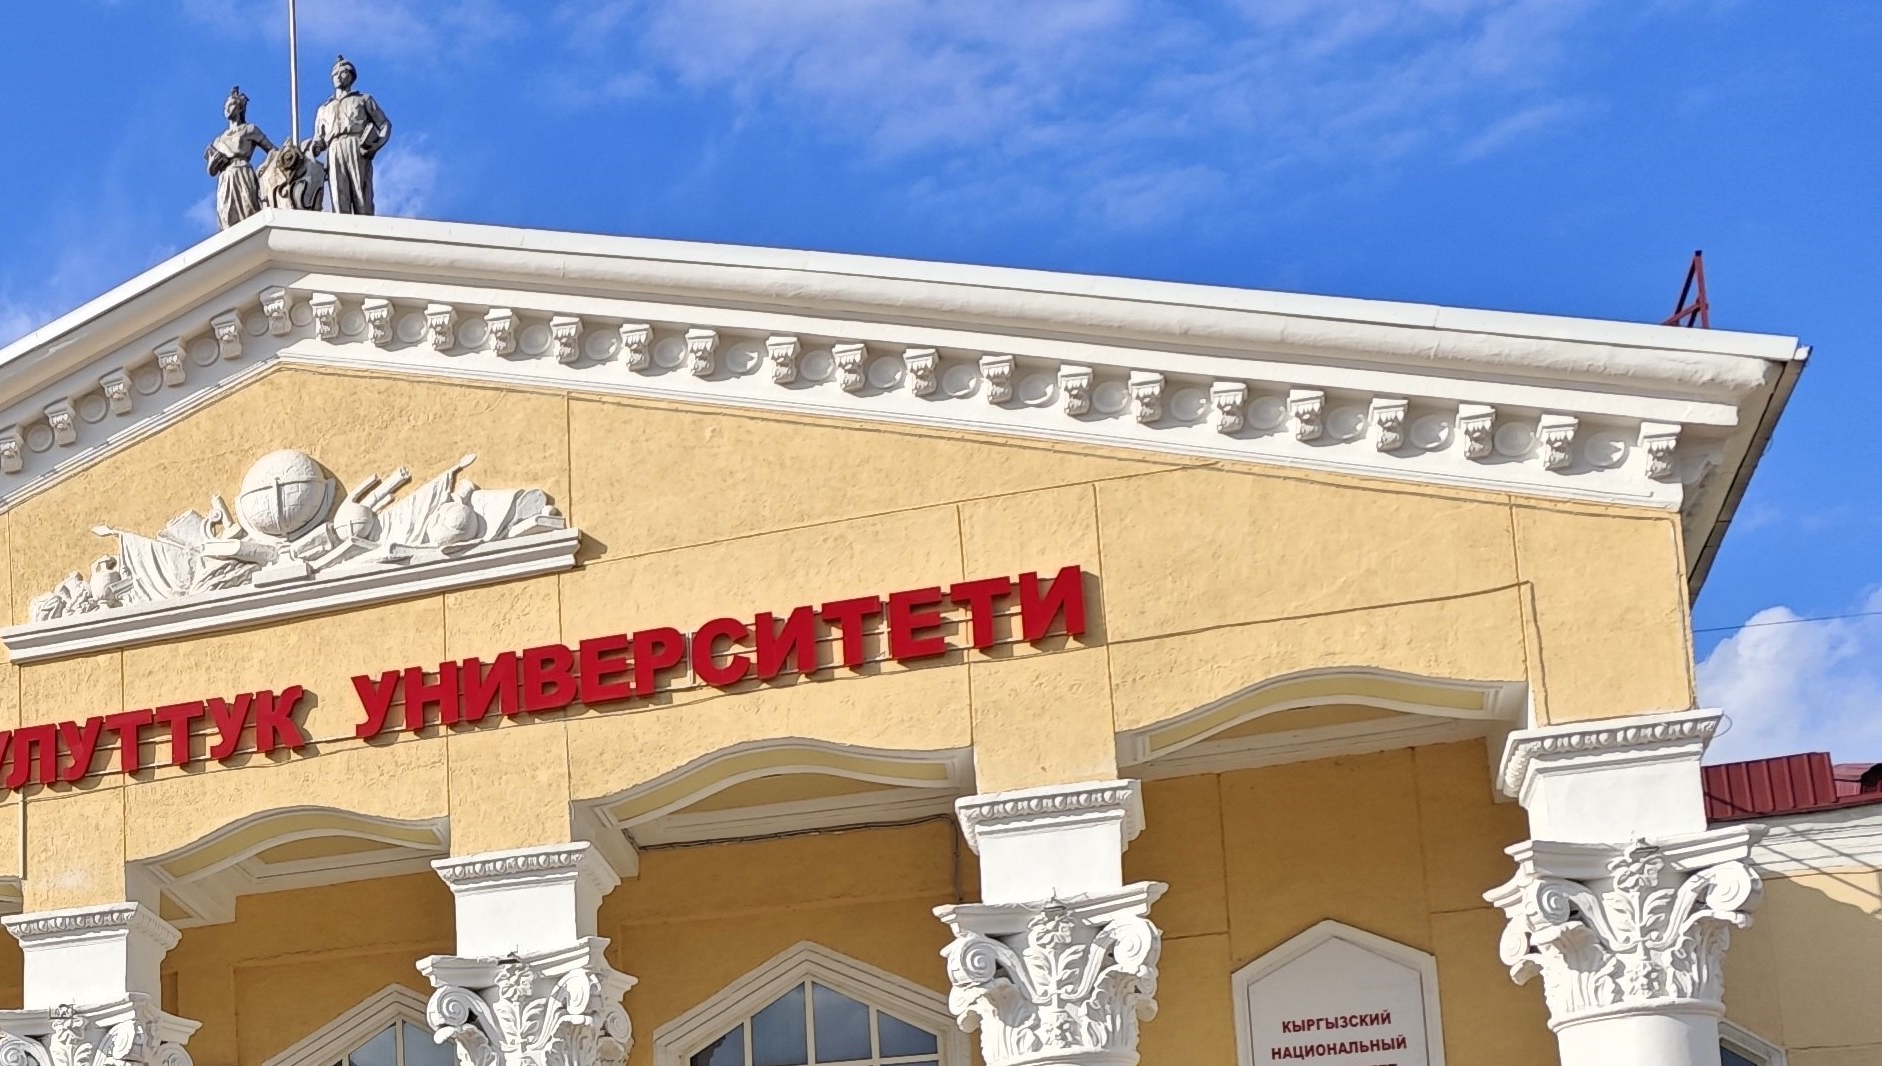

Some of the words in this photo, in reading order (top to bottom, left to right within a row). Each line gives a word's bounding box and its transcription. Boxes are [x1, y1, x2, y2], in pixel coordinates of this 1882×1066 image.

[351, 565, 1085, 739] УНИВЕРСИТЕТИ
[1282, 1009, 1392, 1034] КЫРГЫЗСКИЙ
[1271, 1034, 1407, 1061] НАЦИОНАЛЬНЫЙ
